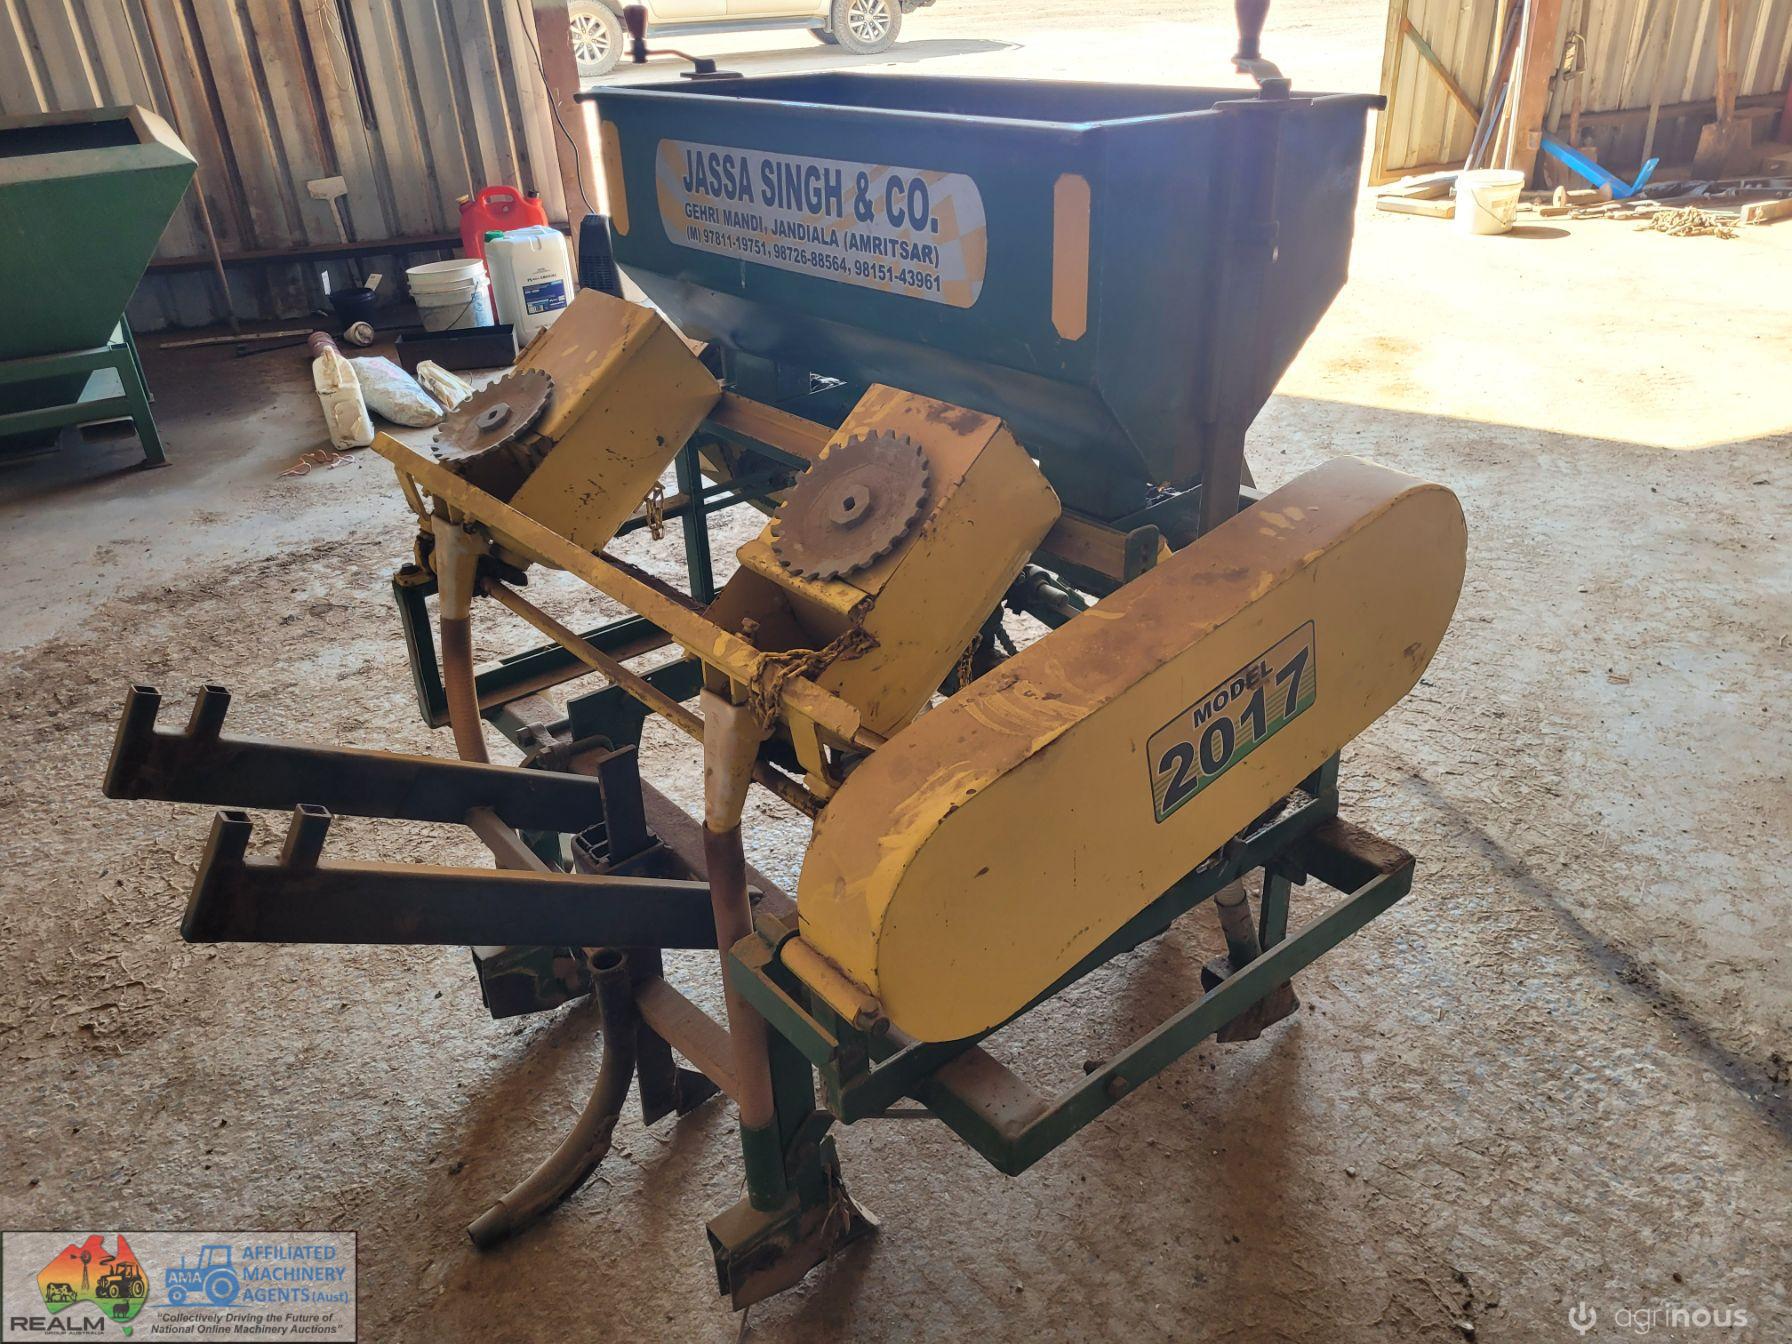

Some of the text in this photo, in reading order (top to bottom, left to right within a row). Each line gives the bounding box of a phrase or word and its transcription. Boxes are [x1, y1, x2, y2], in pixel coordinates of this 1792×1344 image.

[683, 149, 939, 233] JASSA SINGH & CO.
[685, 202, 940, 269] GEHRI MANDI, JANDIALA (AMRITSAR)
[686, 225, 701, 243] (M)
[855, 260, 940, 292] 98151-43961
[1192, 659, 1273, 728] MODEL
[1158, 644, 1309, 814] 2017
